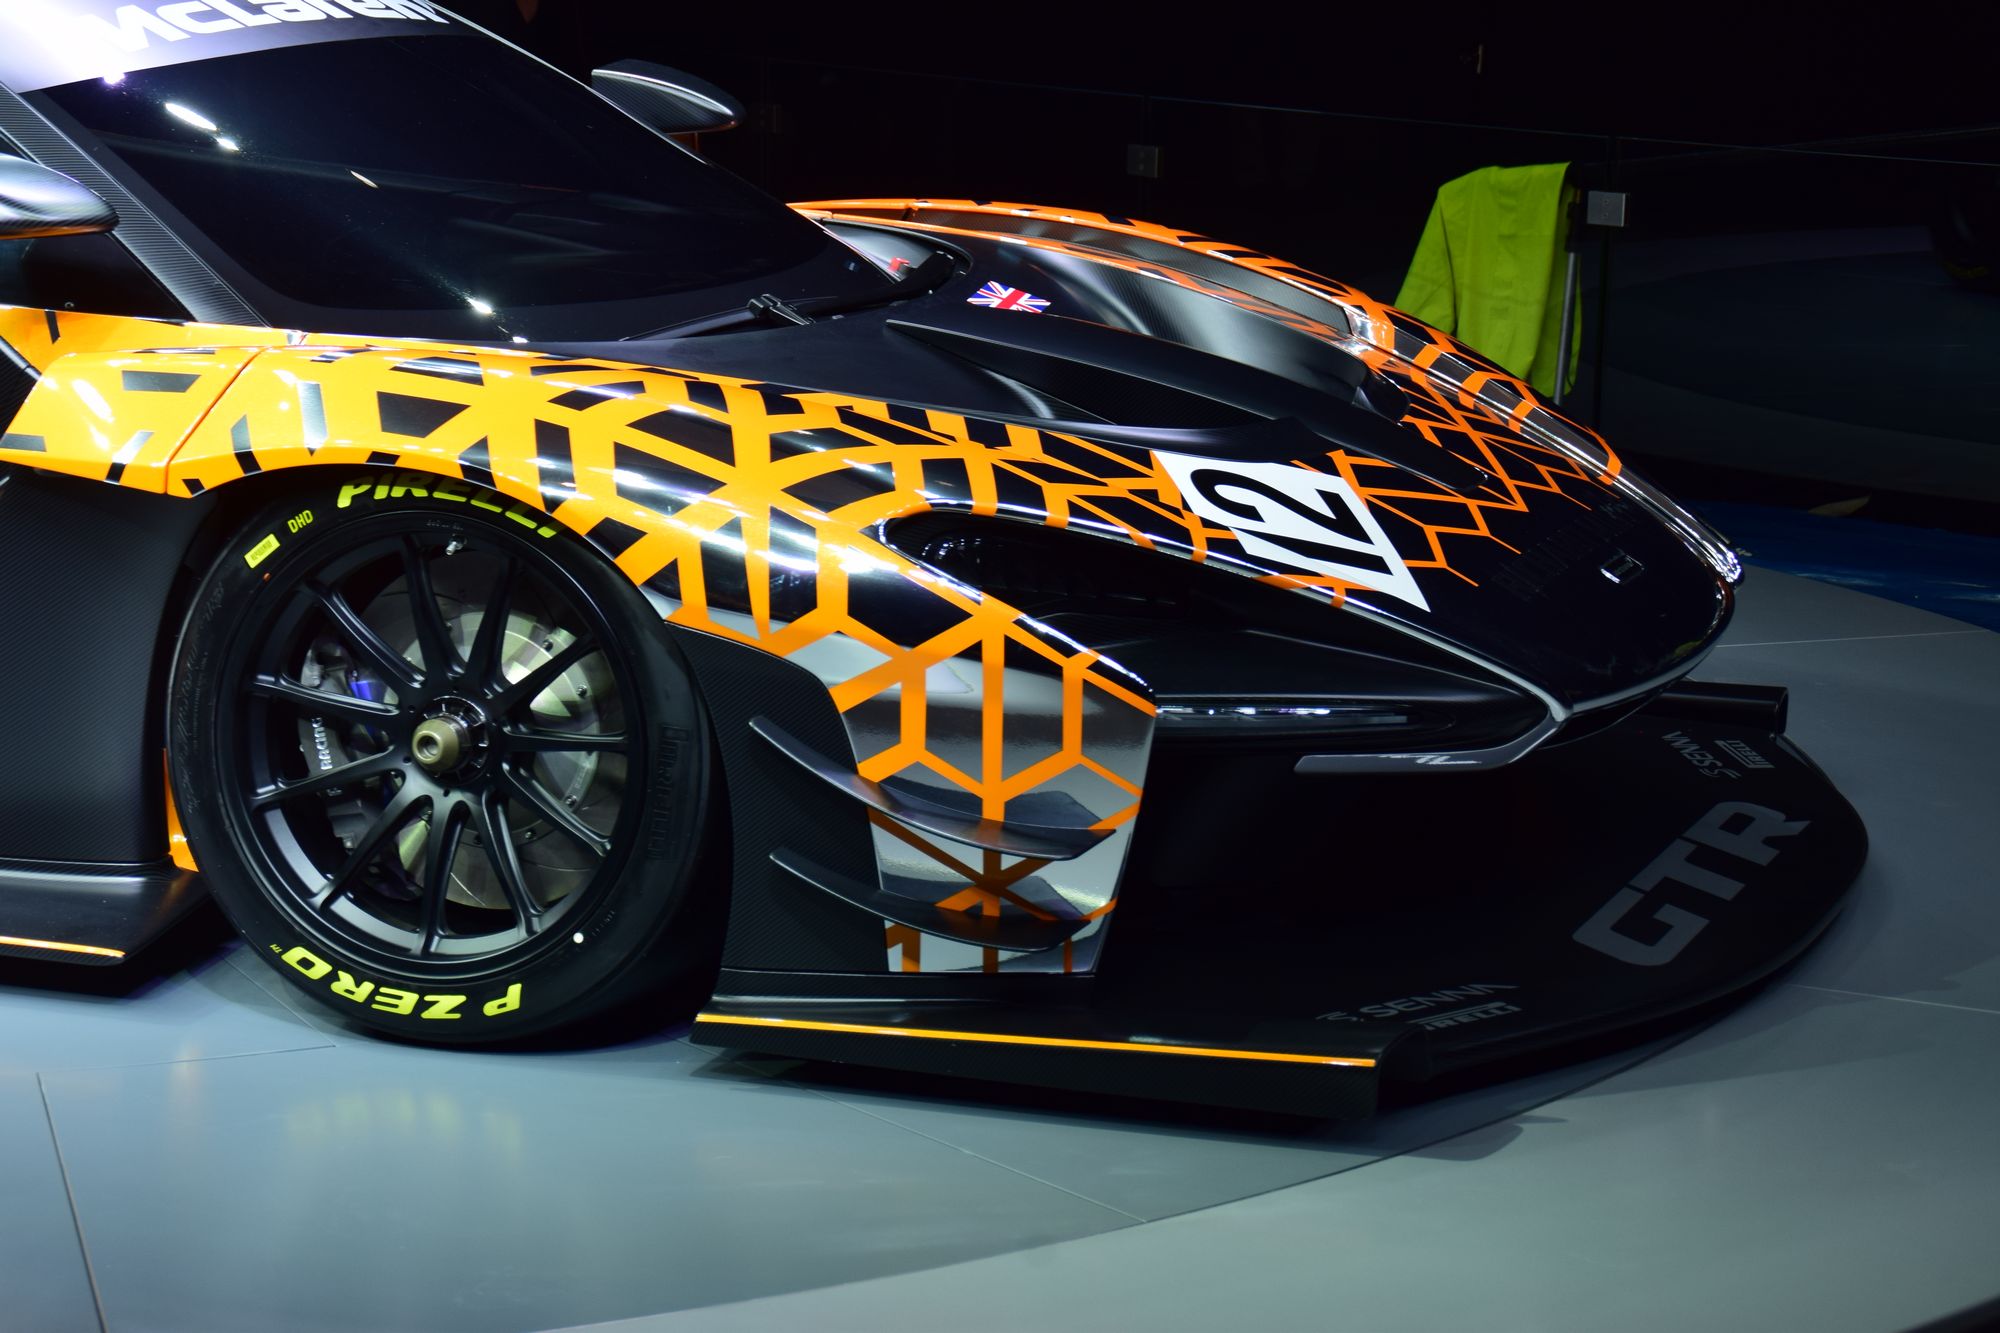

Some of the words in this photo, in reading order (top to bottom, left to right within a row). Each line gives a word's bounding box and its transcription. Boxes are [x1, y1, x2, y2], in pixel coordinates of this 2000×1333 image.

[286, 509, 315, 535] DHD
[336, 472, 562, 539] PIRELLI
[1190, 468, 1395, 577] 12
[1571, 800, 1812, 967] GTR
[280, 945, 468, 1020] ZERO
[481, 981, 523, 1017] P
[1359, 983, 1520, 1019] SENNA
